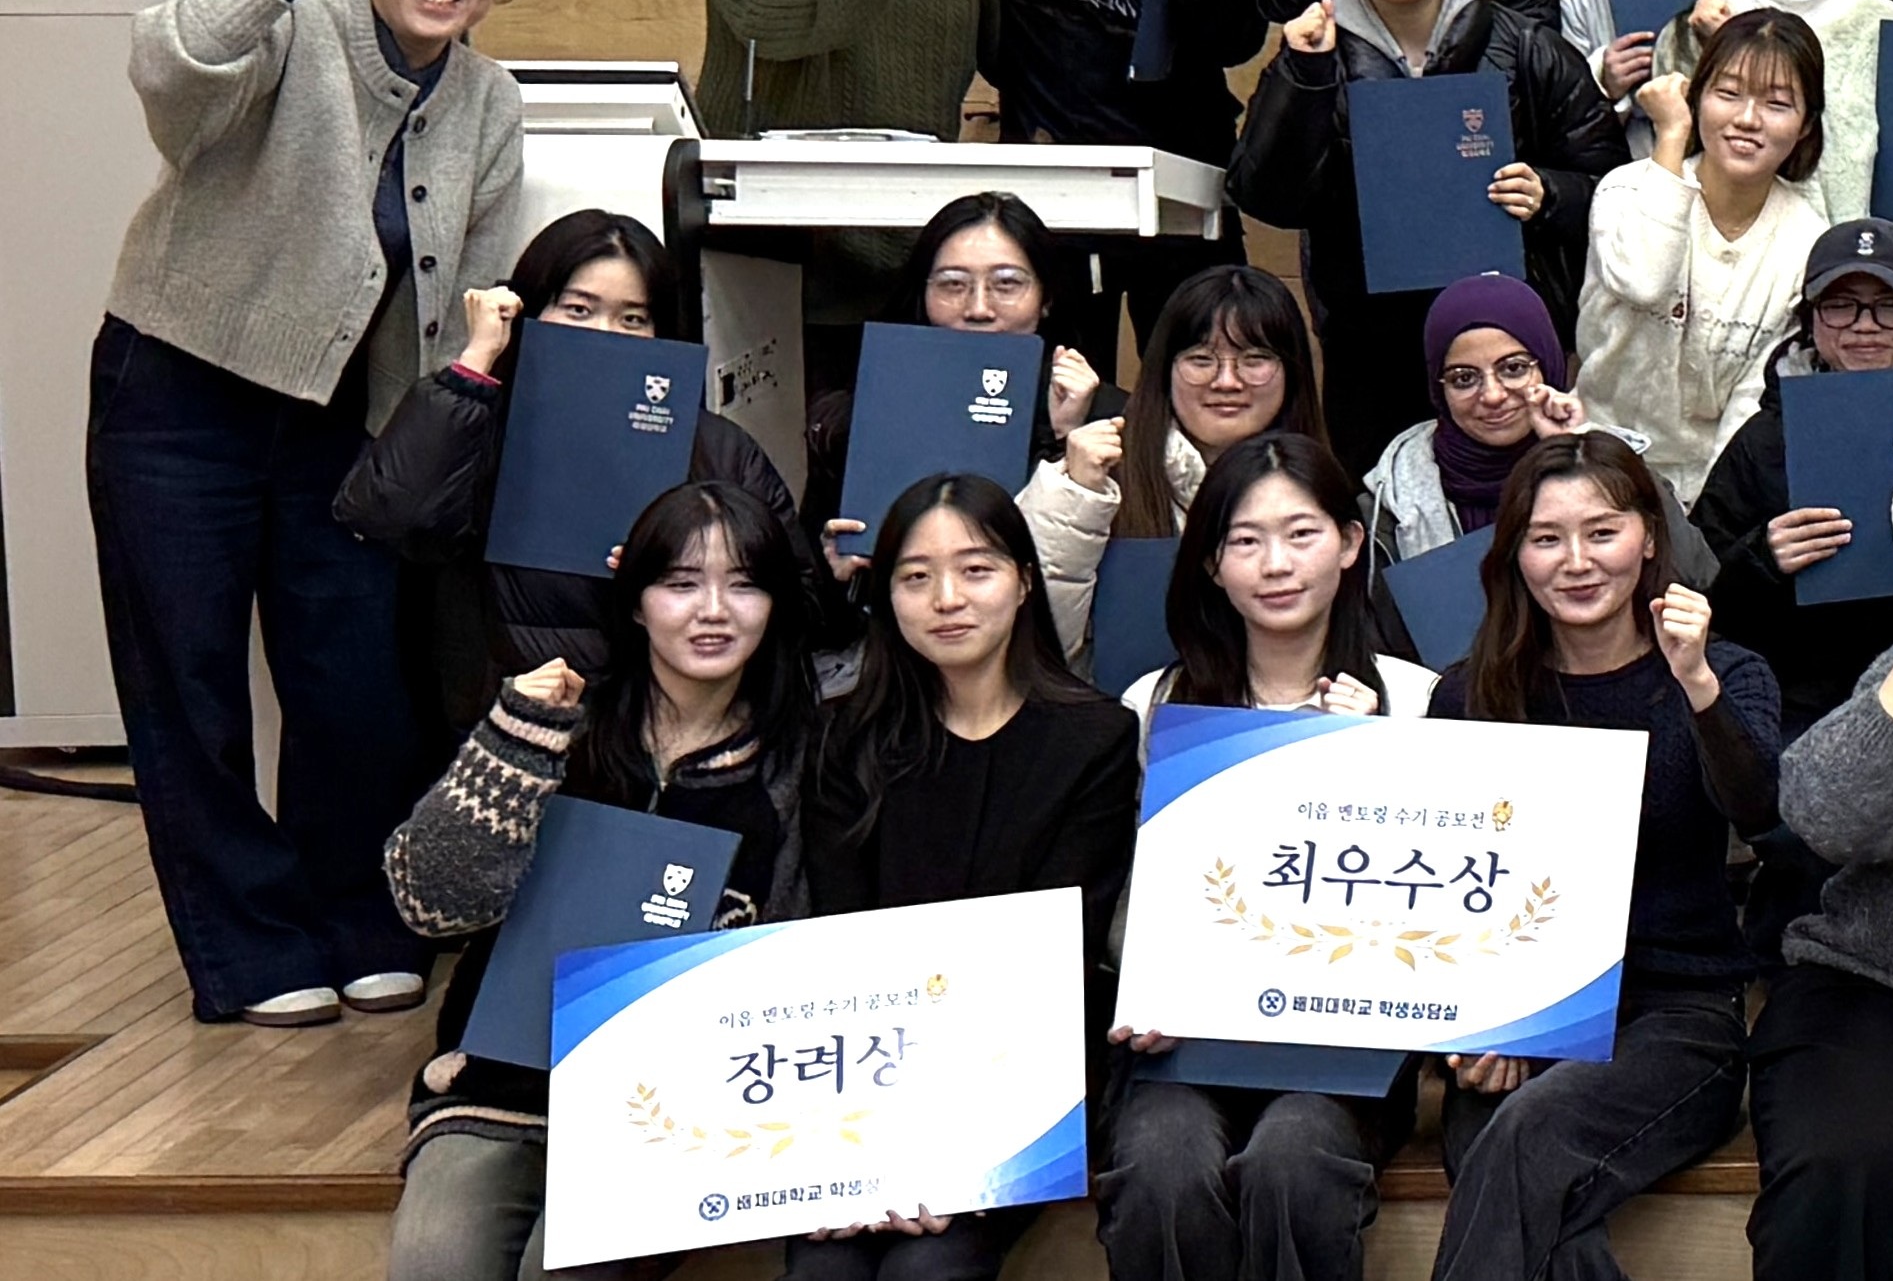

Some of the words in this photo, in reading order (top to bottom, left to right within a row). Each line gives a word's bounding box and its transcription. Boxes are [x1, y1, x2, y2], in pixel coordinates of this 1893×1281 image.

[1298, 801, 1328, 821] 이음
[1395, 807, 1427, 826] 수기
[1262, 839, 1511, 914] 최우수상
[1378, 1000, 1458, 1022] 학생상담실
[726, 1027, 918, 1105] 장려상
